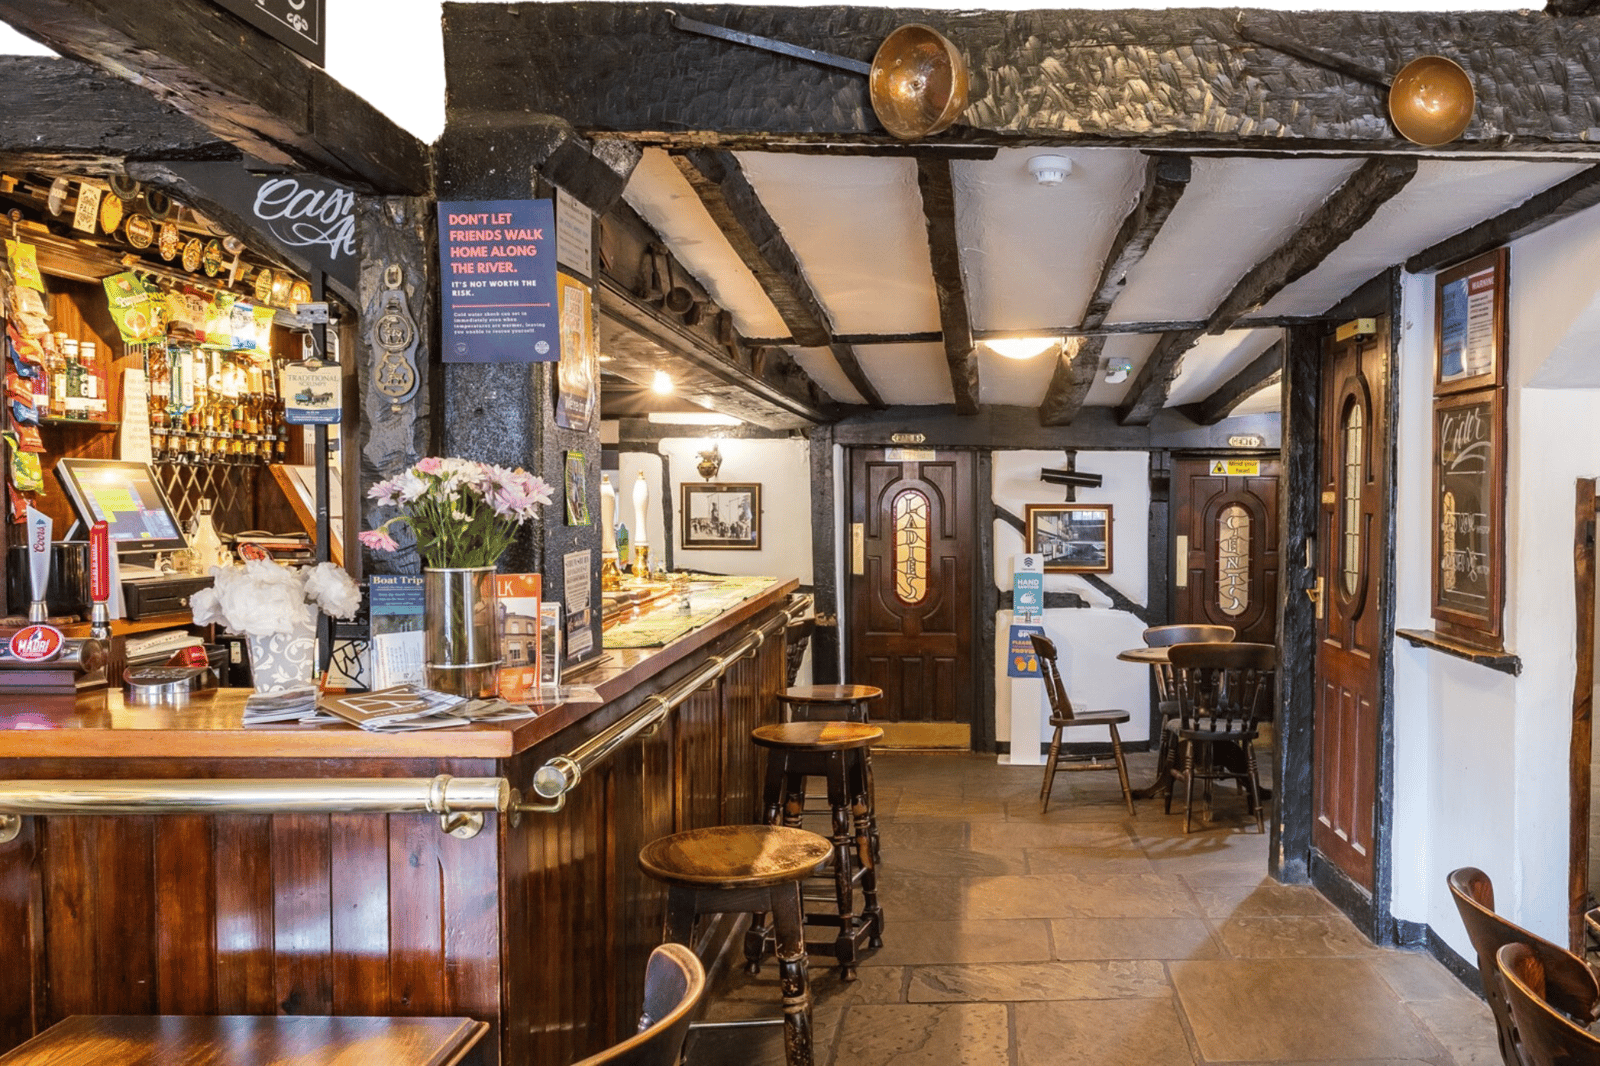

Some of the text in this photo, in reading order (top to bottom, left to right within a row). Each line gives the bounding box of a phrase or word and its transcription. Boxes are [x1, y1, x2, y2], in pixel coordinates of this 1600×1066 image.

[253, 178, 355, 224] Cas
[448, 212, 512, 226] DON'T LET
[449, 228, 543, 242] FRIENDS WALK
[450, 245, 537, 258] HOME ALONG
[450, 261, 518, 274] THE RIVER.
[451, 289, 474, 297] RISK.
[288, 374, 339, 382] TRADITIONAL
[1441, 408, 1484, 466] Cider
[33, 525, 47, 553] Coors
[904, 498, 918, 599] LADIES
[1226, 515, 1240, 611] GENTS
[372, 576, 398, 585] Boat
[1017, 578, 1040, 586] HAND
